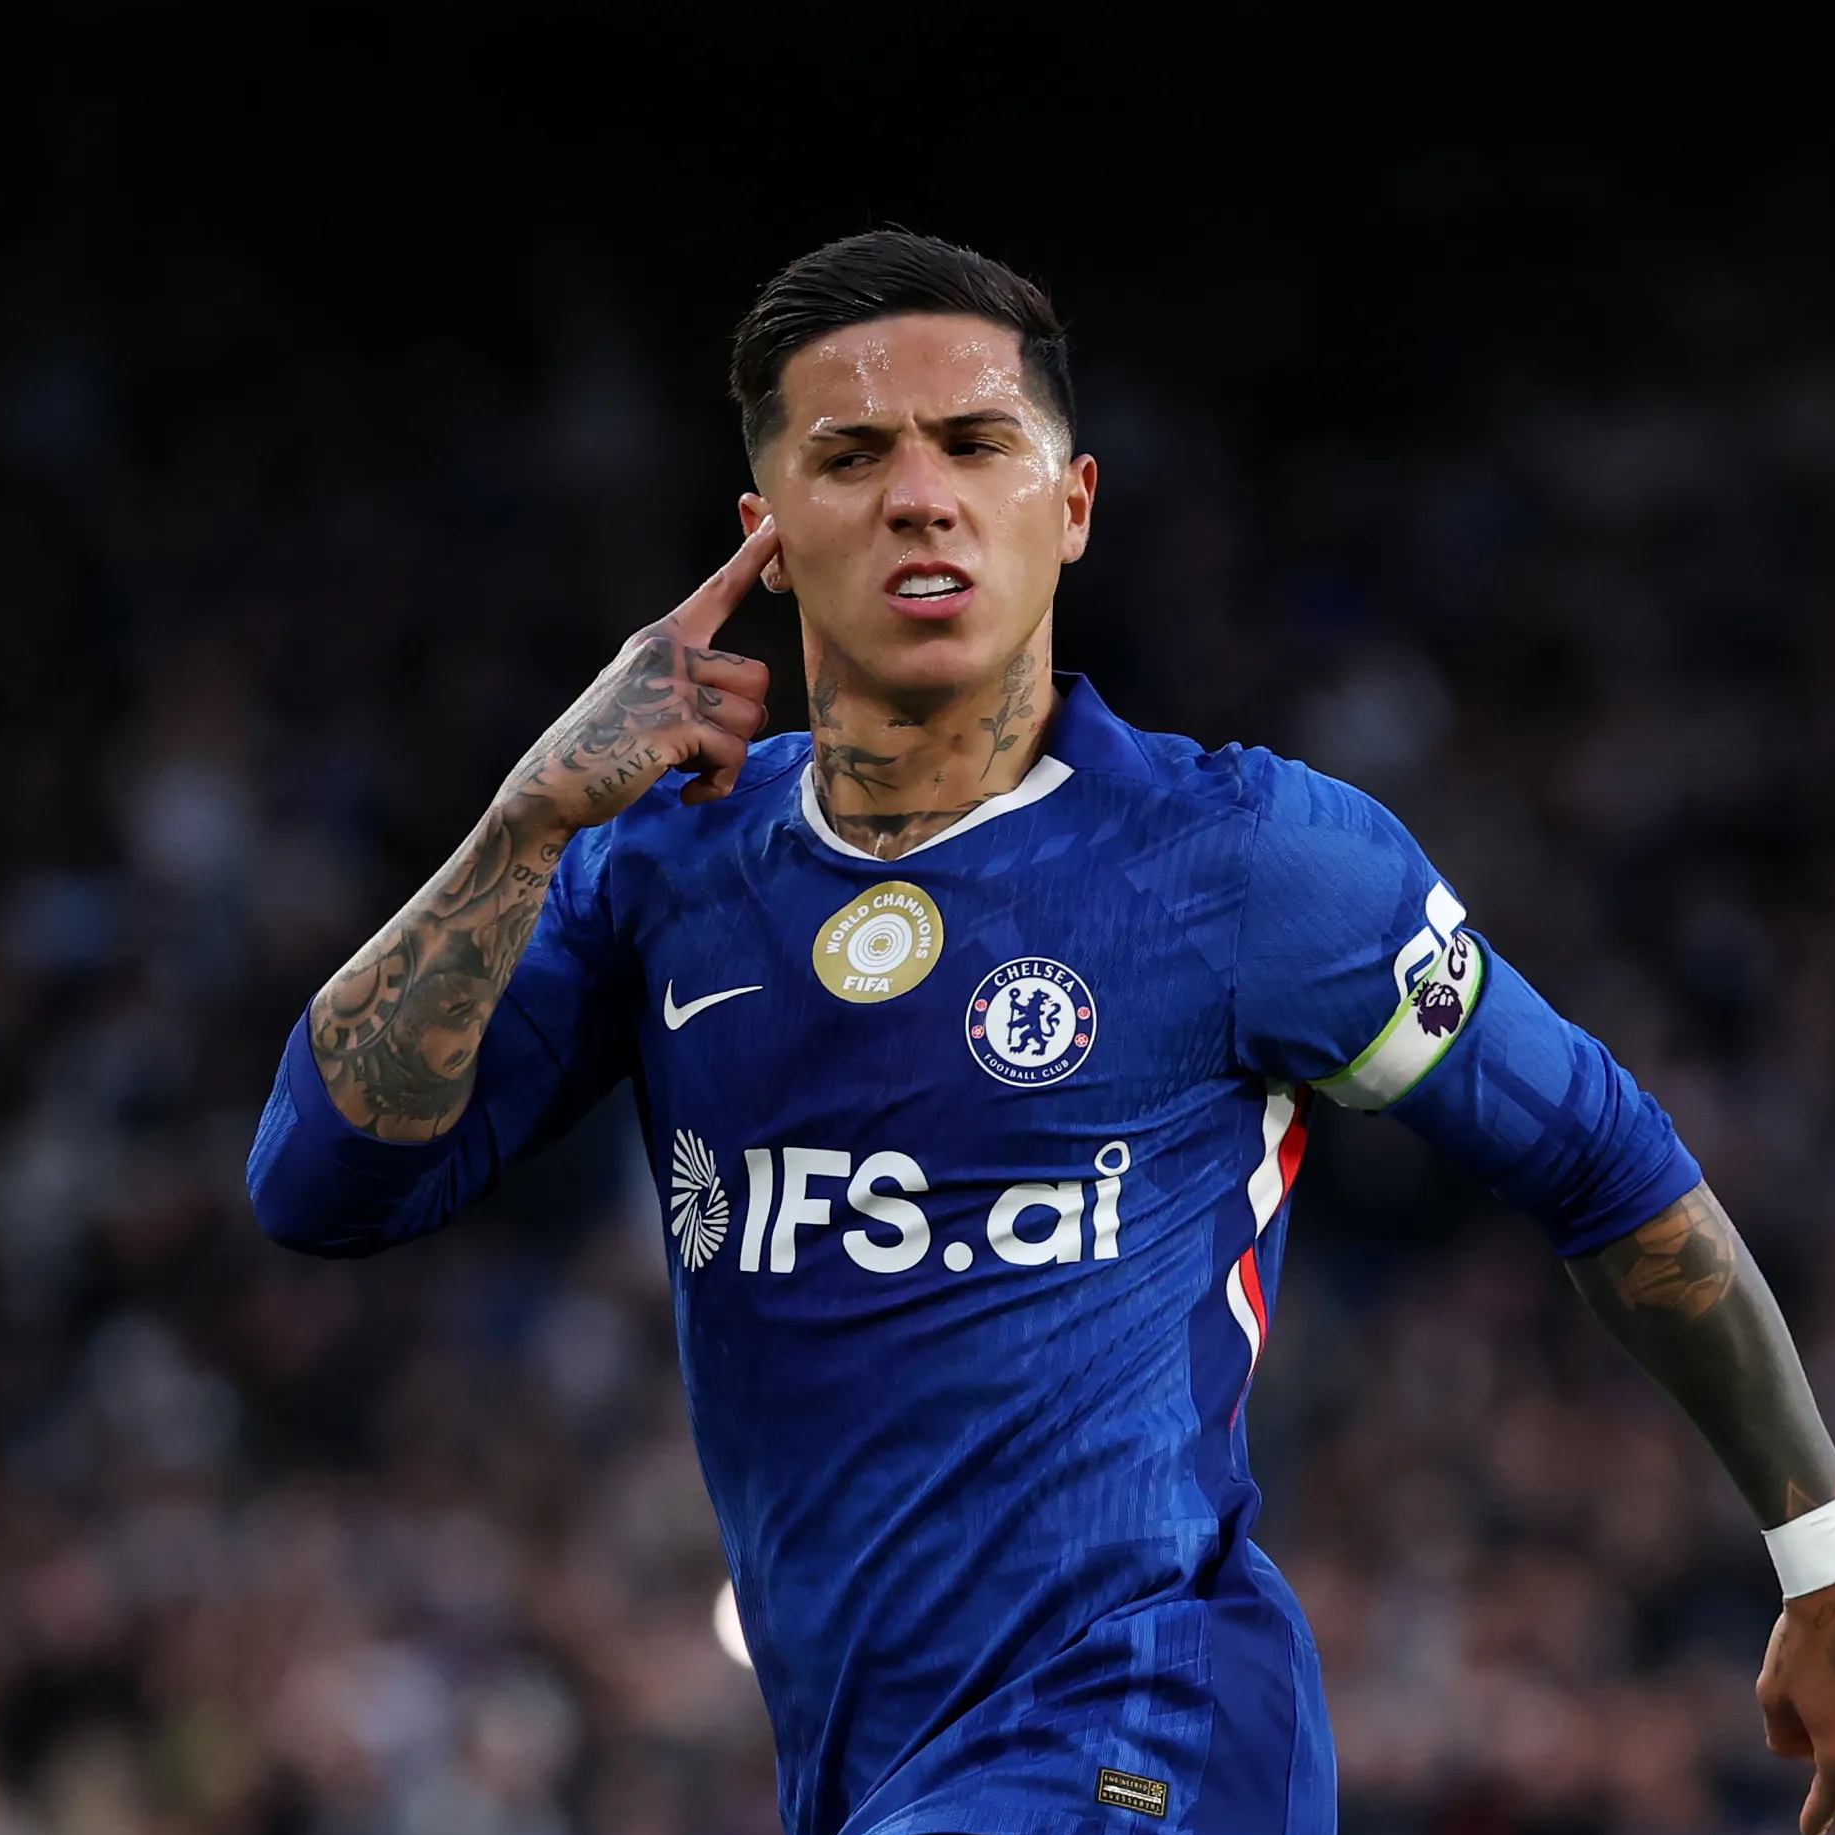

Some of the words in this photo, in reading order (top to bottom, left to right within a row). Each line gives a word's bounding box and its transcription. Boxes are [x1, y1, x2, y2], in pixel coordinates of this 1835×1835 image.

[584, 745, 662, 801] BRAVE
[826, 905, 869, 954] WORLD
[873, 893, 932, 959] CHAMPIONS
[994, 962, 1075, 993] CHELSEA
[1448, 930, 1471, 980] ca
[842, 976, 890, 992] FIFA
[983, 1053, 1037, 1080] FOOTBALL
[1041, 1059, 1069, 1078] CLUB
[740, 1140, 1131, 1273] IFS.ai
